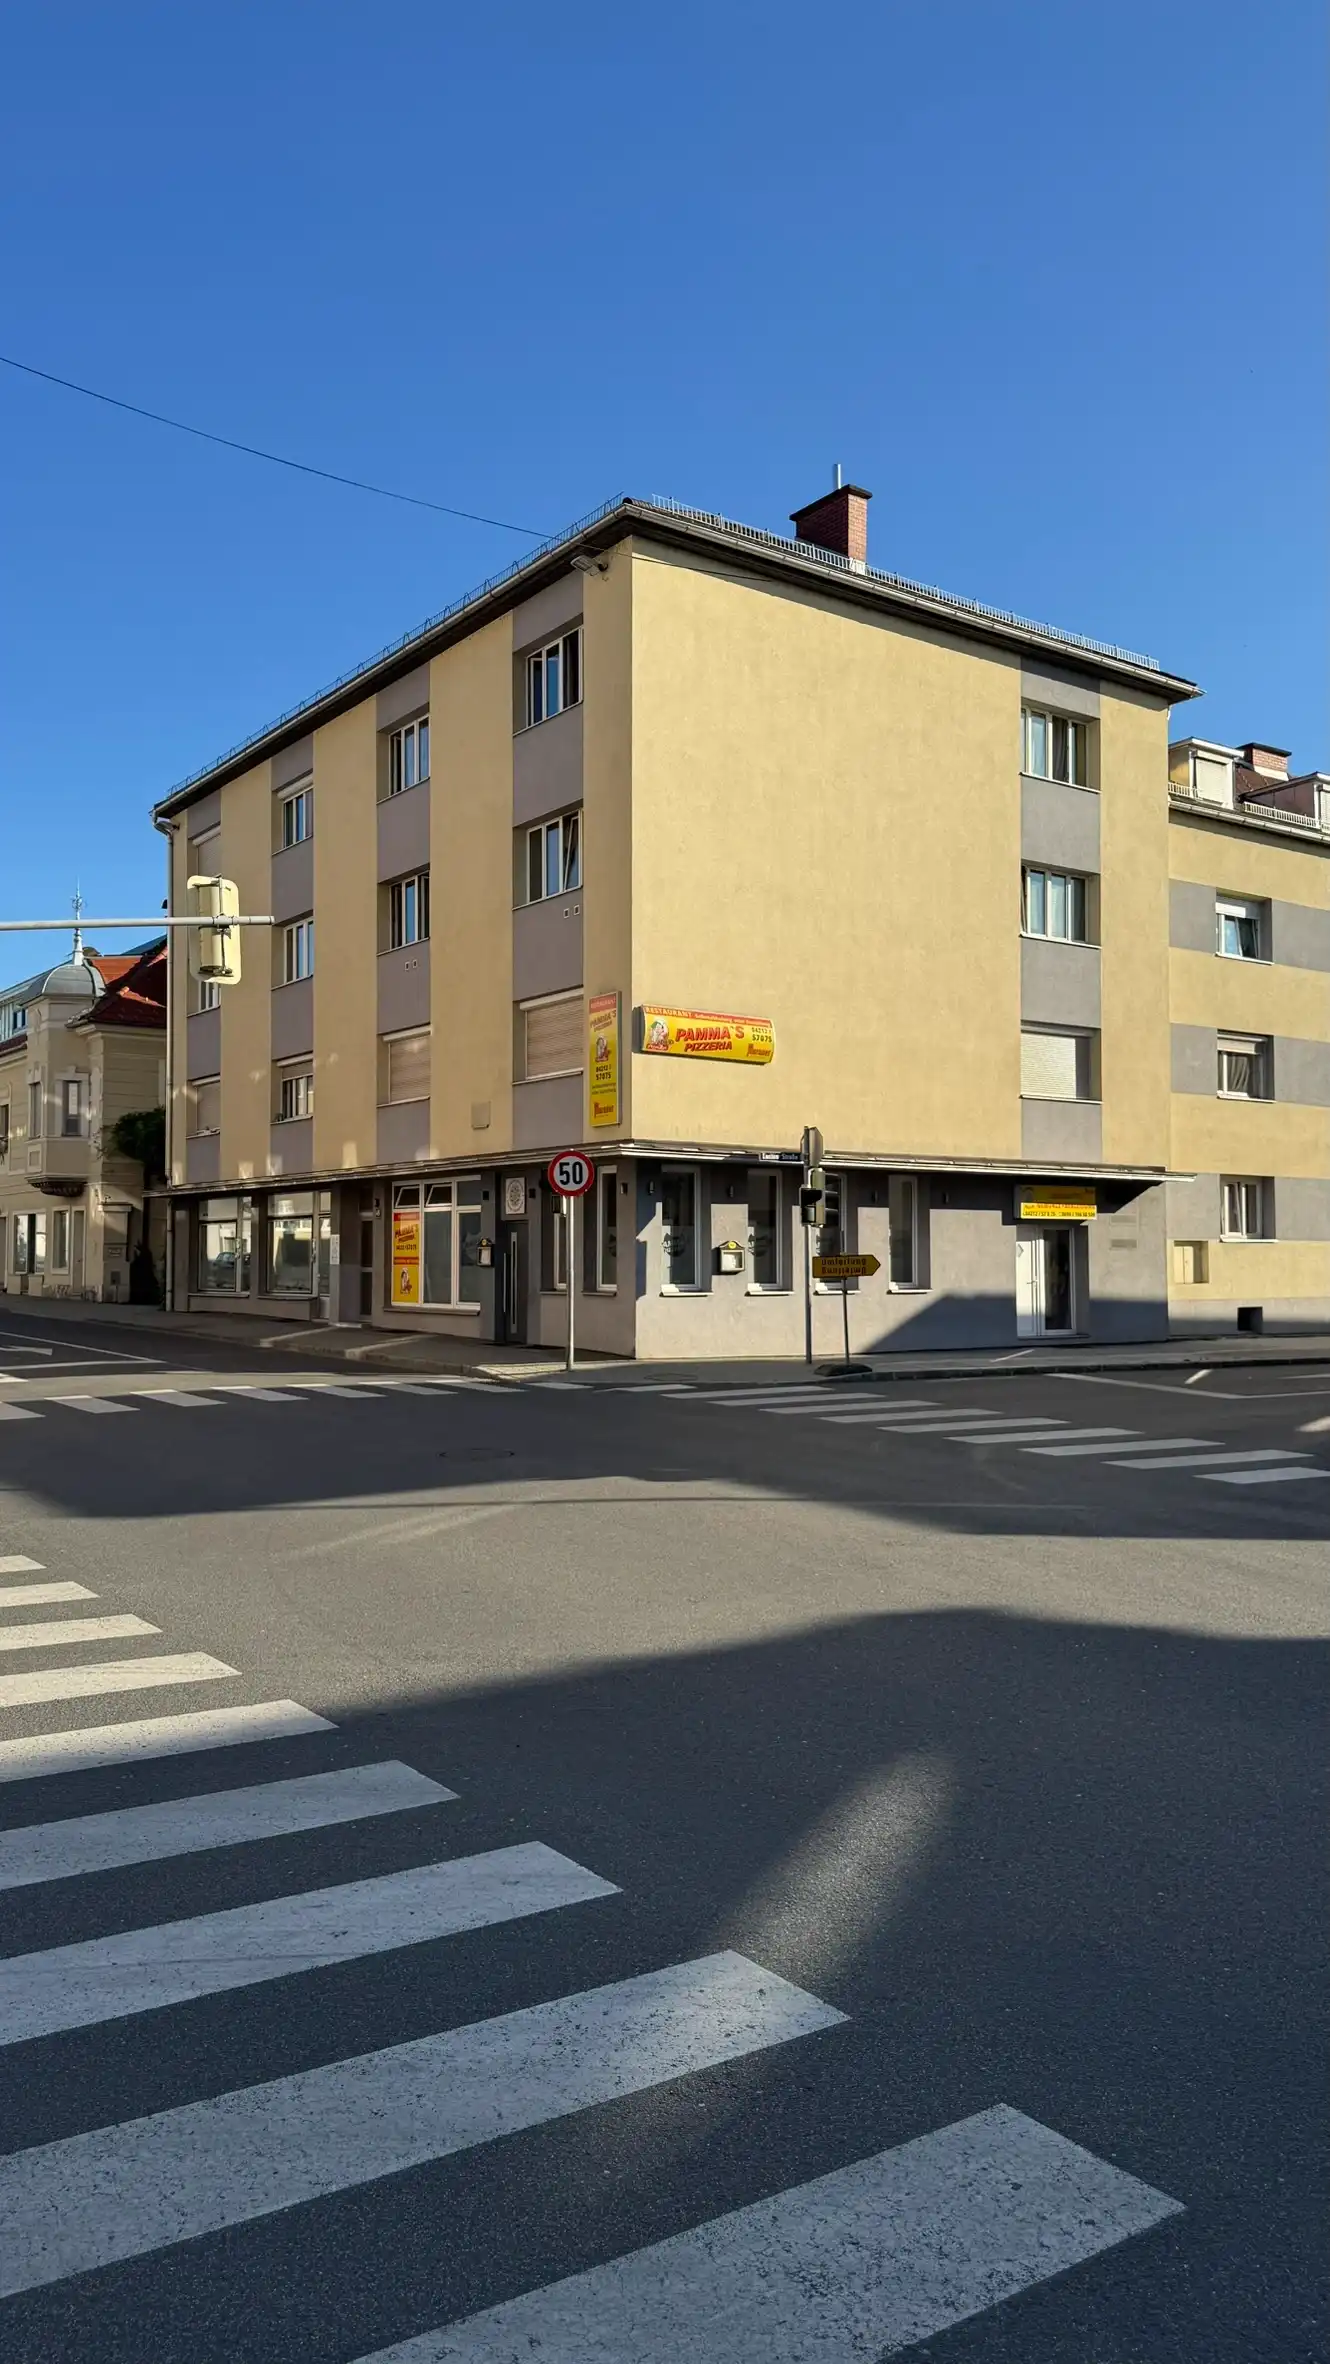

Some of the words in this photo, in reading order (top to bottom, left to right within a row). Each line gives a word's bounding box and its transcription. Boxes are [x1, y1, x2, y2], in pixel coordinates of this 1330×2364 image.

[645, 1006, 693, 1018] RESTAURANT
[752, 1034, 772, 1043] 57075
[684, 1040, 733, 1052] PIZZERIA
[595, 1072, 612, 1081] 57075
[559, 1162, 583, 1185] 50
[821, 1258, 866, 1266] Umleitung
